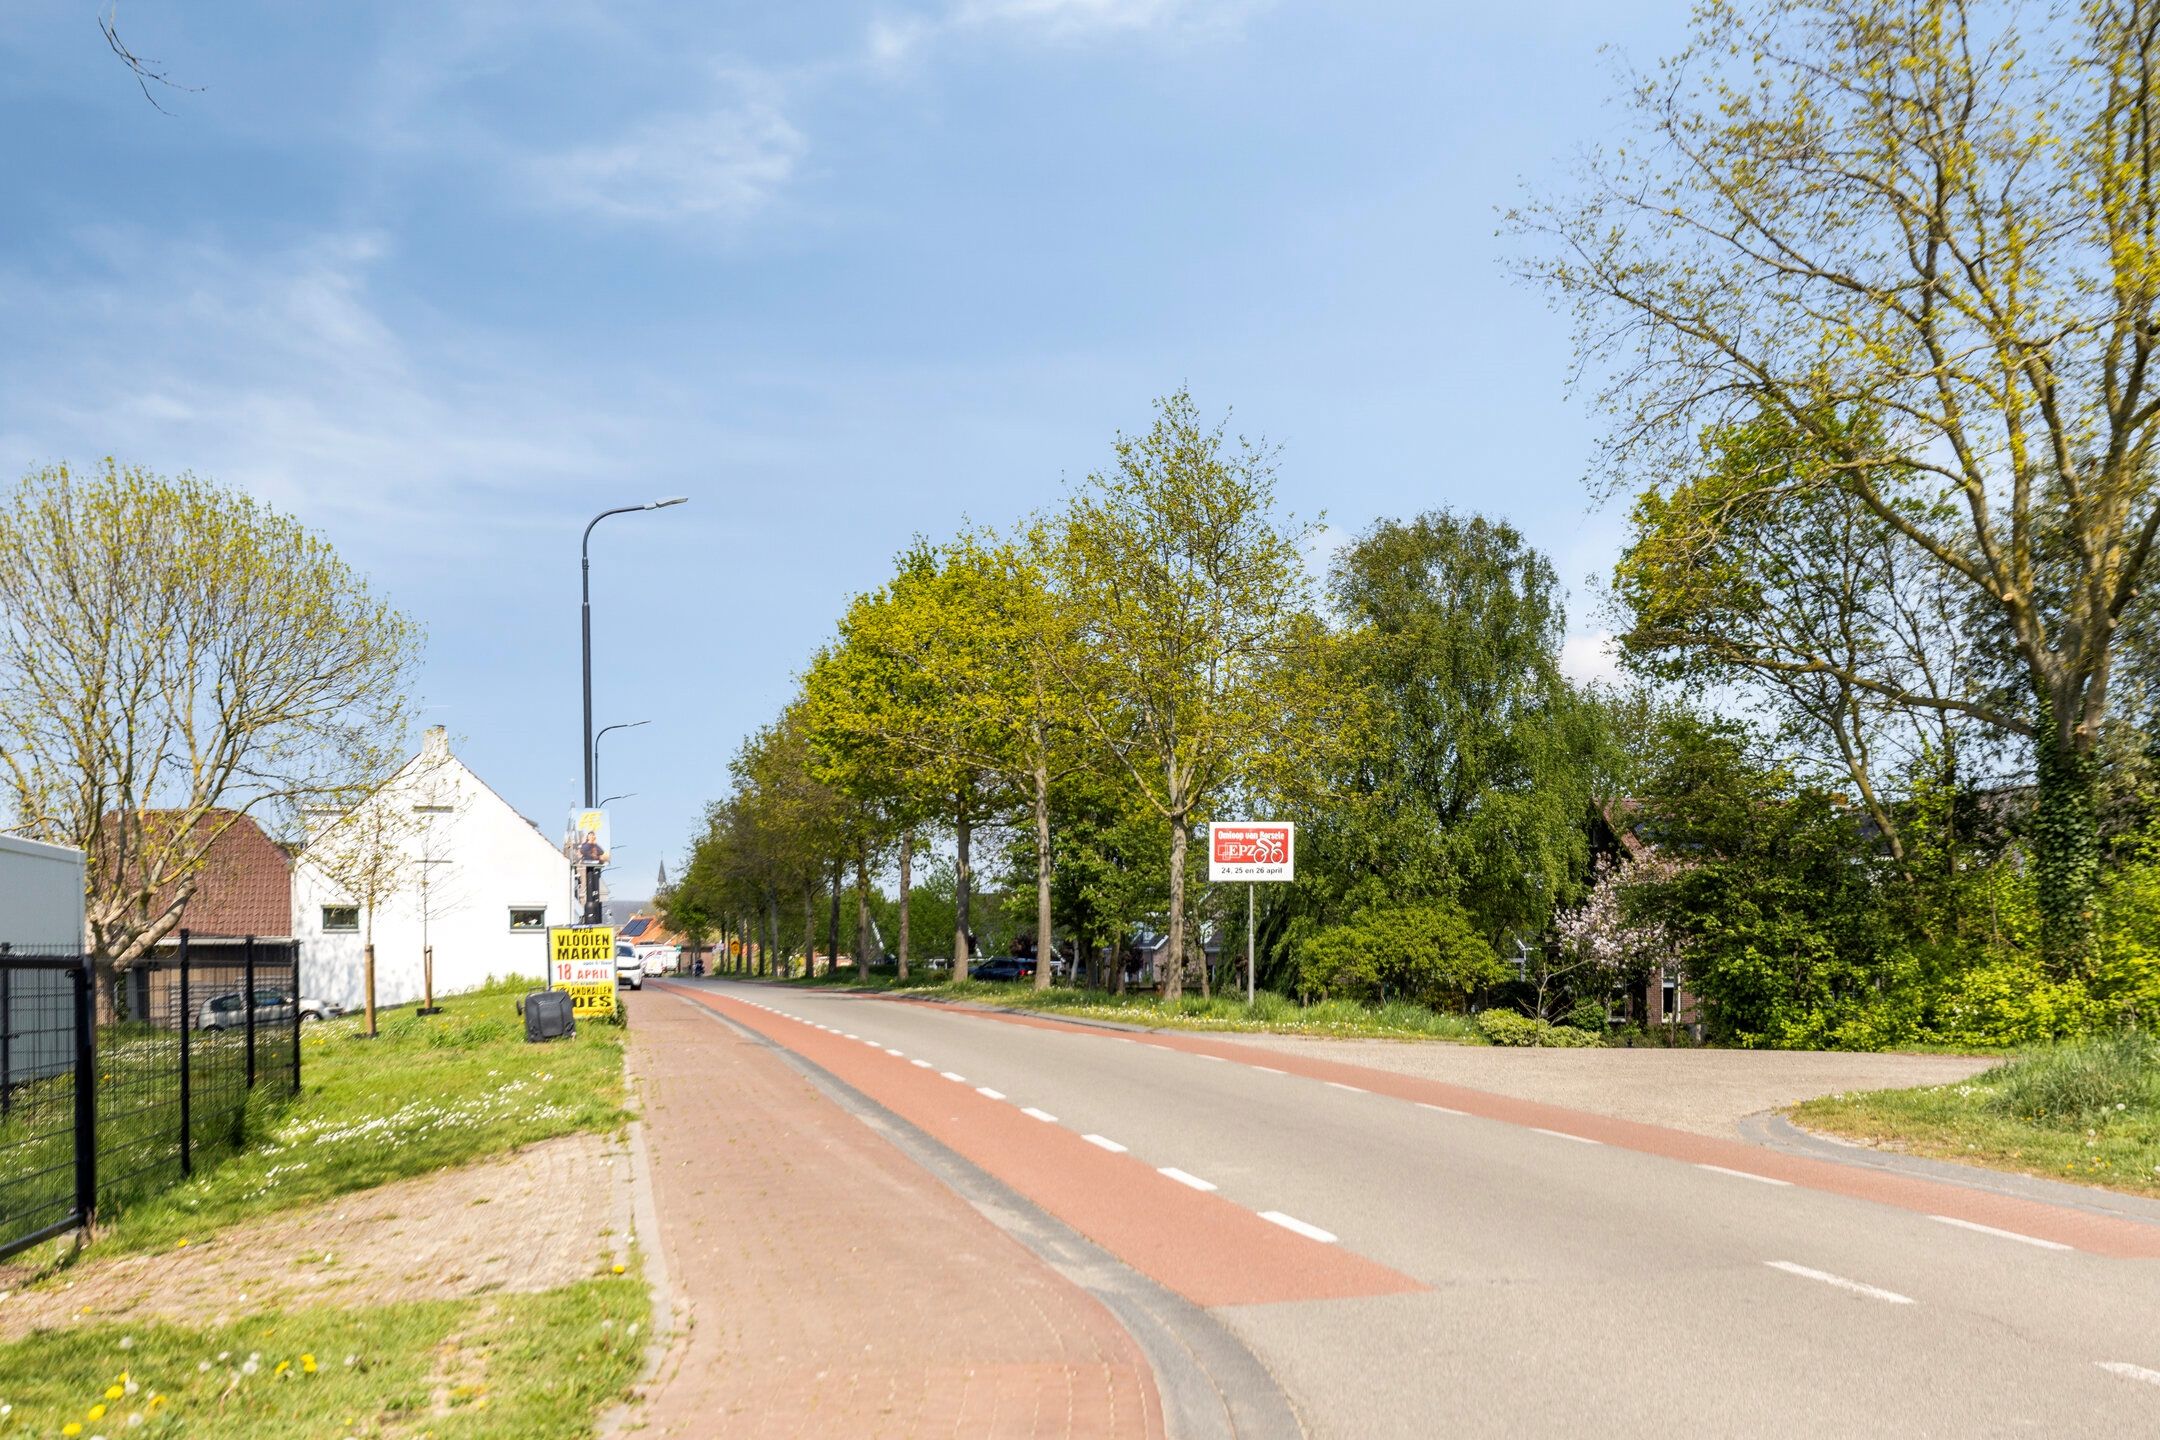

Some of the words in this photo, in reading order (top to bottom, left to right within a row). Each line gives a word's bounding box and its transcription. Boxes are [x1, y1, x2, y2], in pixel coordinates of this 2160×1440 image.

[1218, 831, 1244, 840] Omloop
[1245, 832, 1258, 840] van
[1230, 844, 1257, 856] EPZ
[1221, 867, 1233, 875] 24,
[1266, 867, 1283, 875] april
[557, 935, 610, 947] VLOOIEN
[557, 947, 611, 960] MARKT
[557, 963, 572, 980] 18
[577, 968, 609, 980] APRIL
[572, 996, 612, 1008] OES
